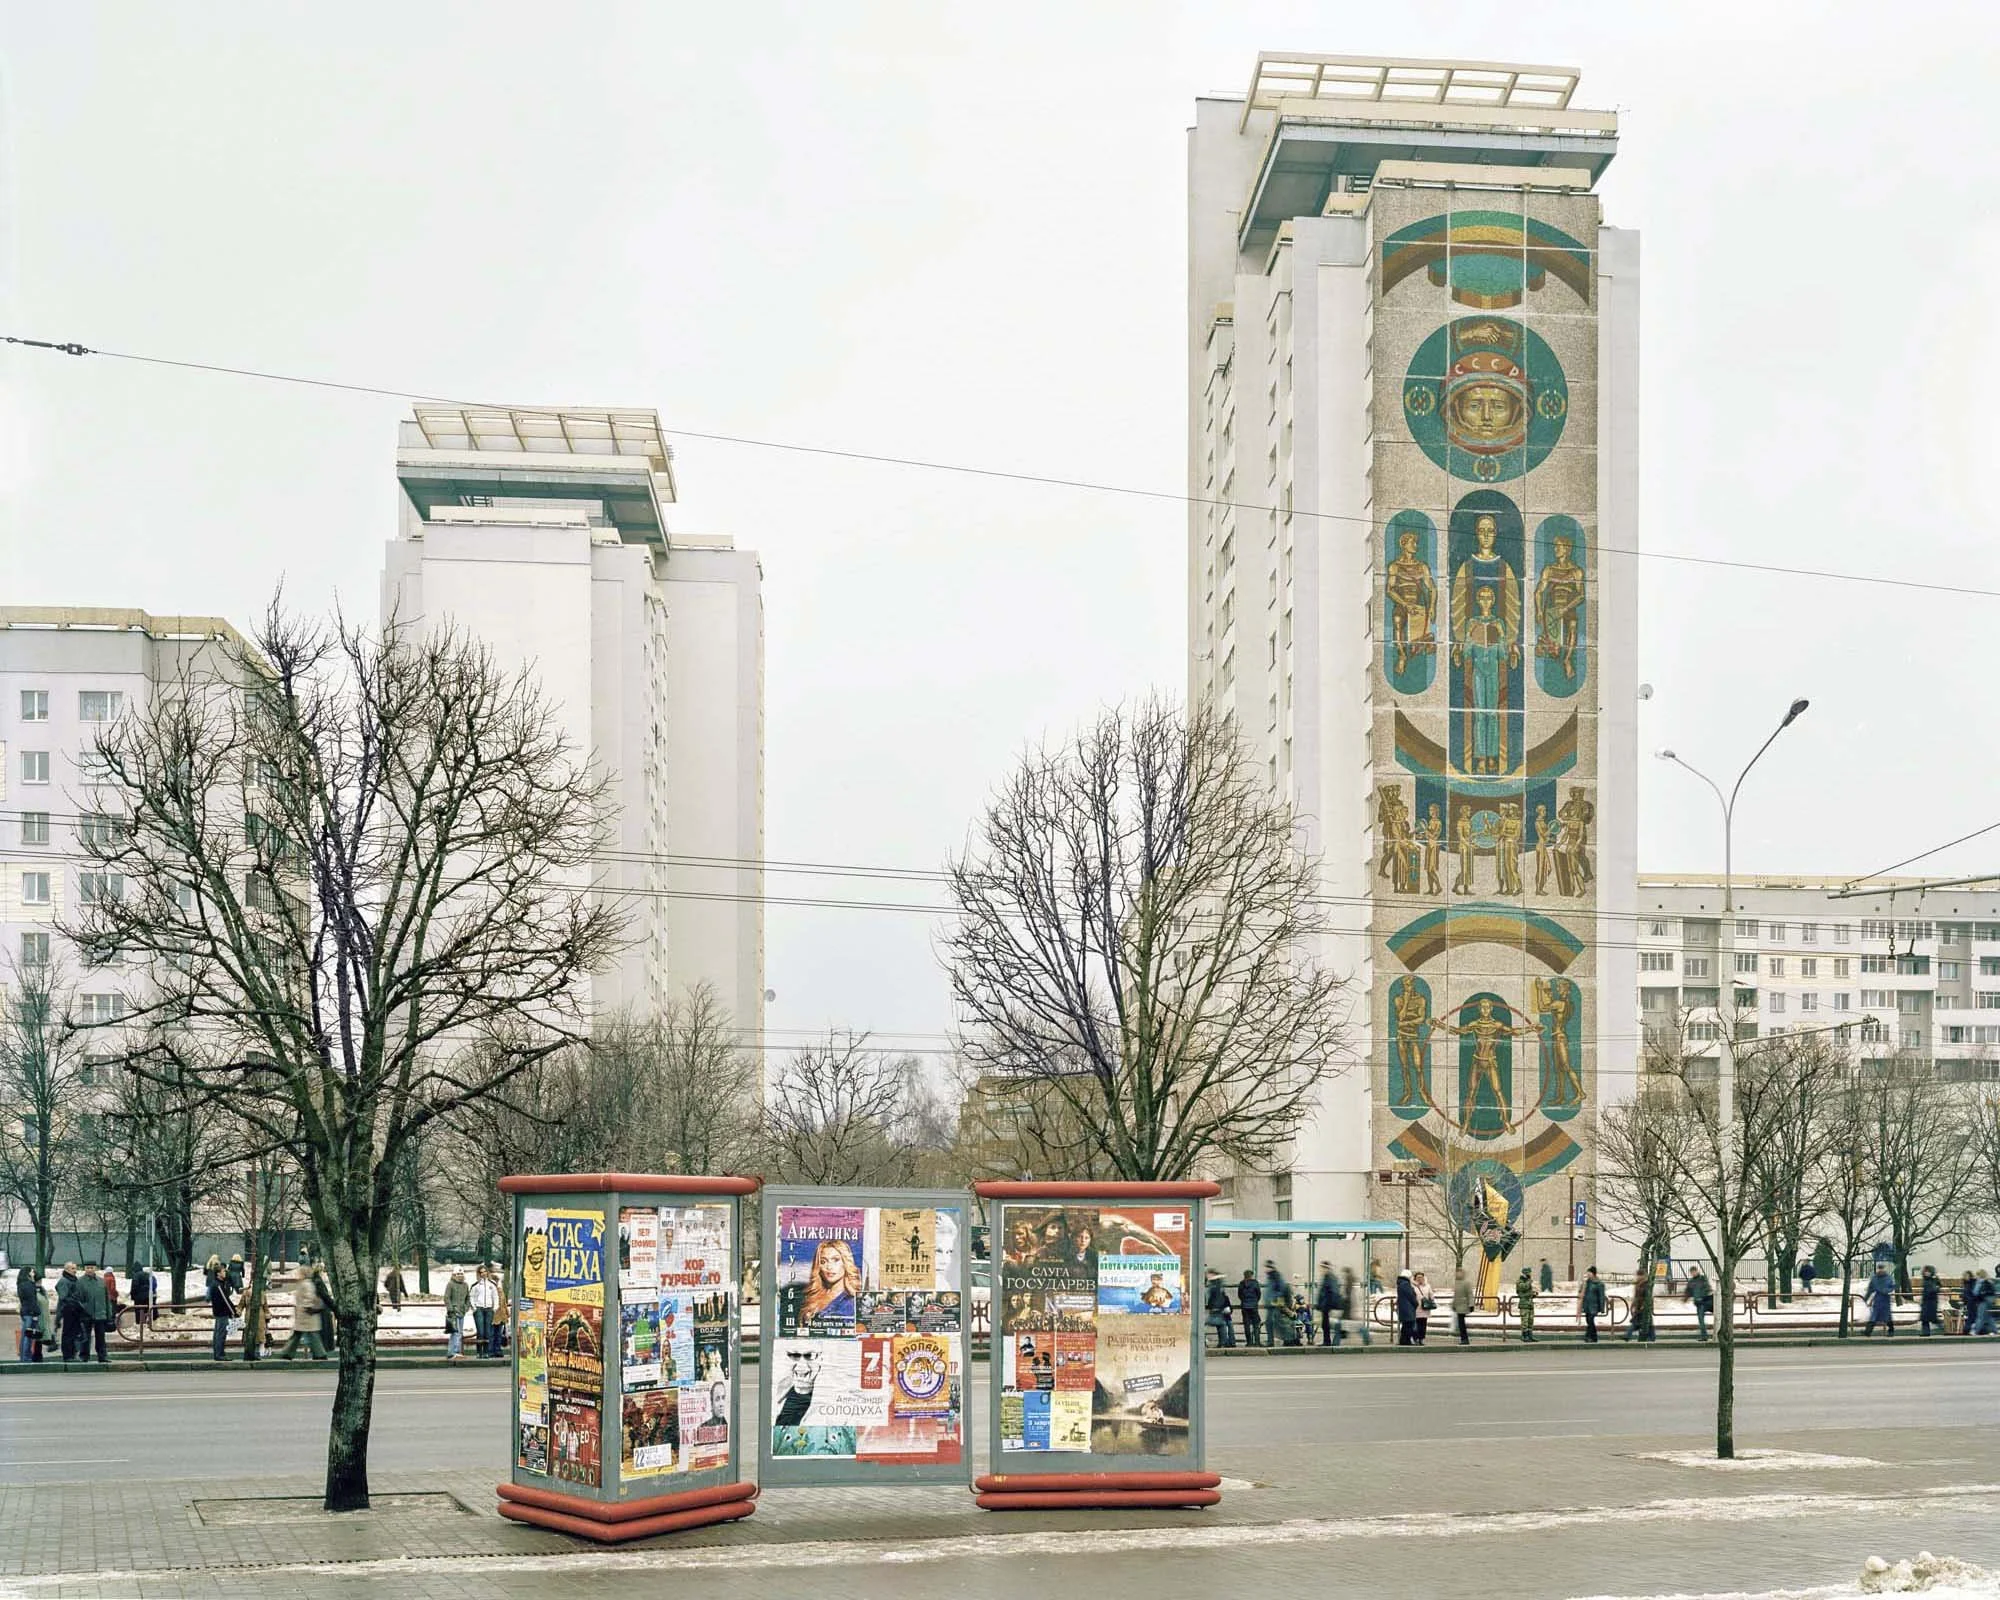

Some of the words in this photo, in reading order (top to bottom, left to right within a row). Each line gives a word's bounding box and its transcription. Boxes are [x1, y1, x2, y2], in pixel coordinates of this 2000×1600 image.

[1454, 357, 1520, 377] СССР
[549, 1221, 584, 1249] СТАС
[787, 1221, 859, 1241] Анжелика
[547, 1247, 602, 1282] ПЬЕХА
[684, 1258, 706, 1271] ХОР
[1031, 1266, 1071, 1278] СЛУГА
[1099, 1262, 1121, 1271] ОХОТА
[1006, 1277, 1097, 1291] ГОСУДАРЕВ
[897, 1342, 946, 1358] ЗООПАРК
[863, 1352, 881, 1373] 7
[819, 1405, 882, 1416] СОЛОДУХА
